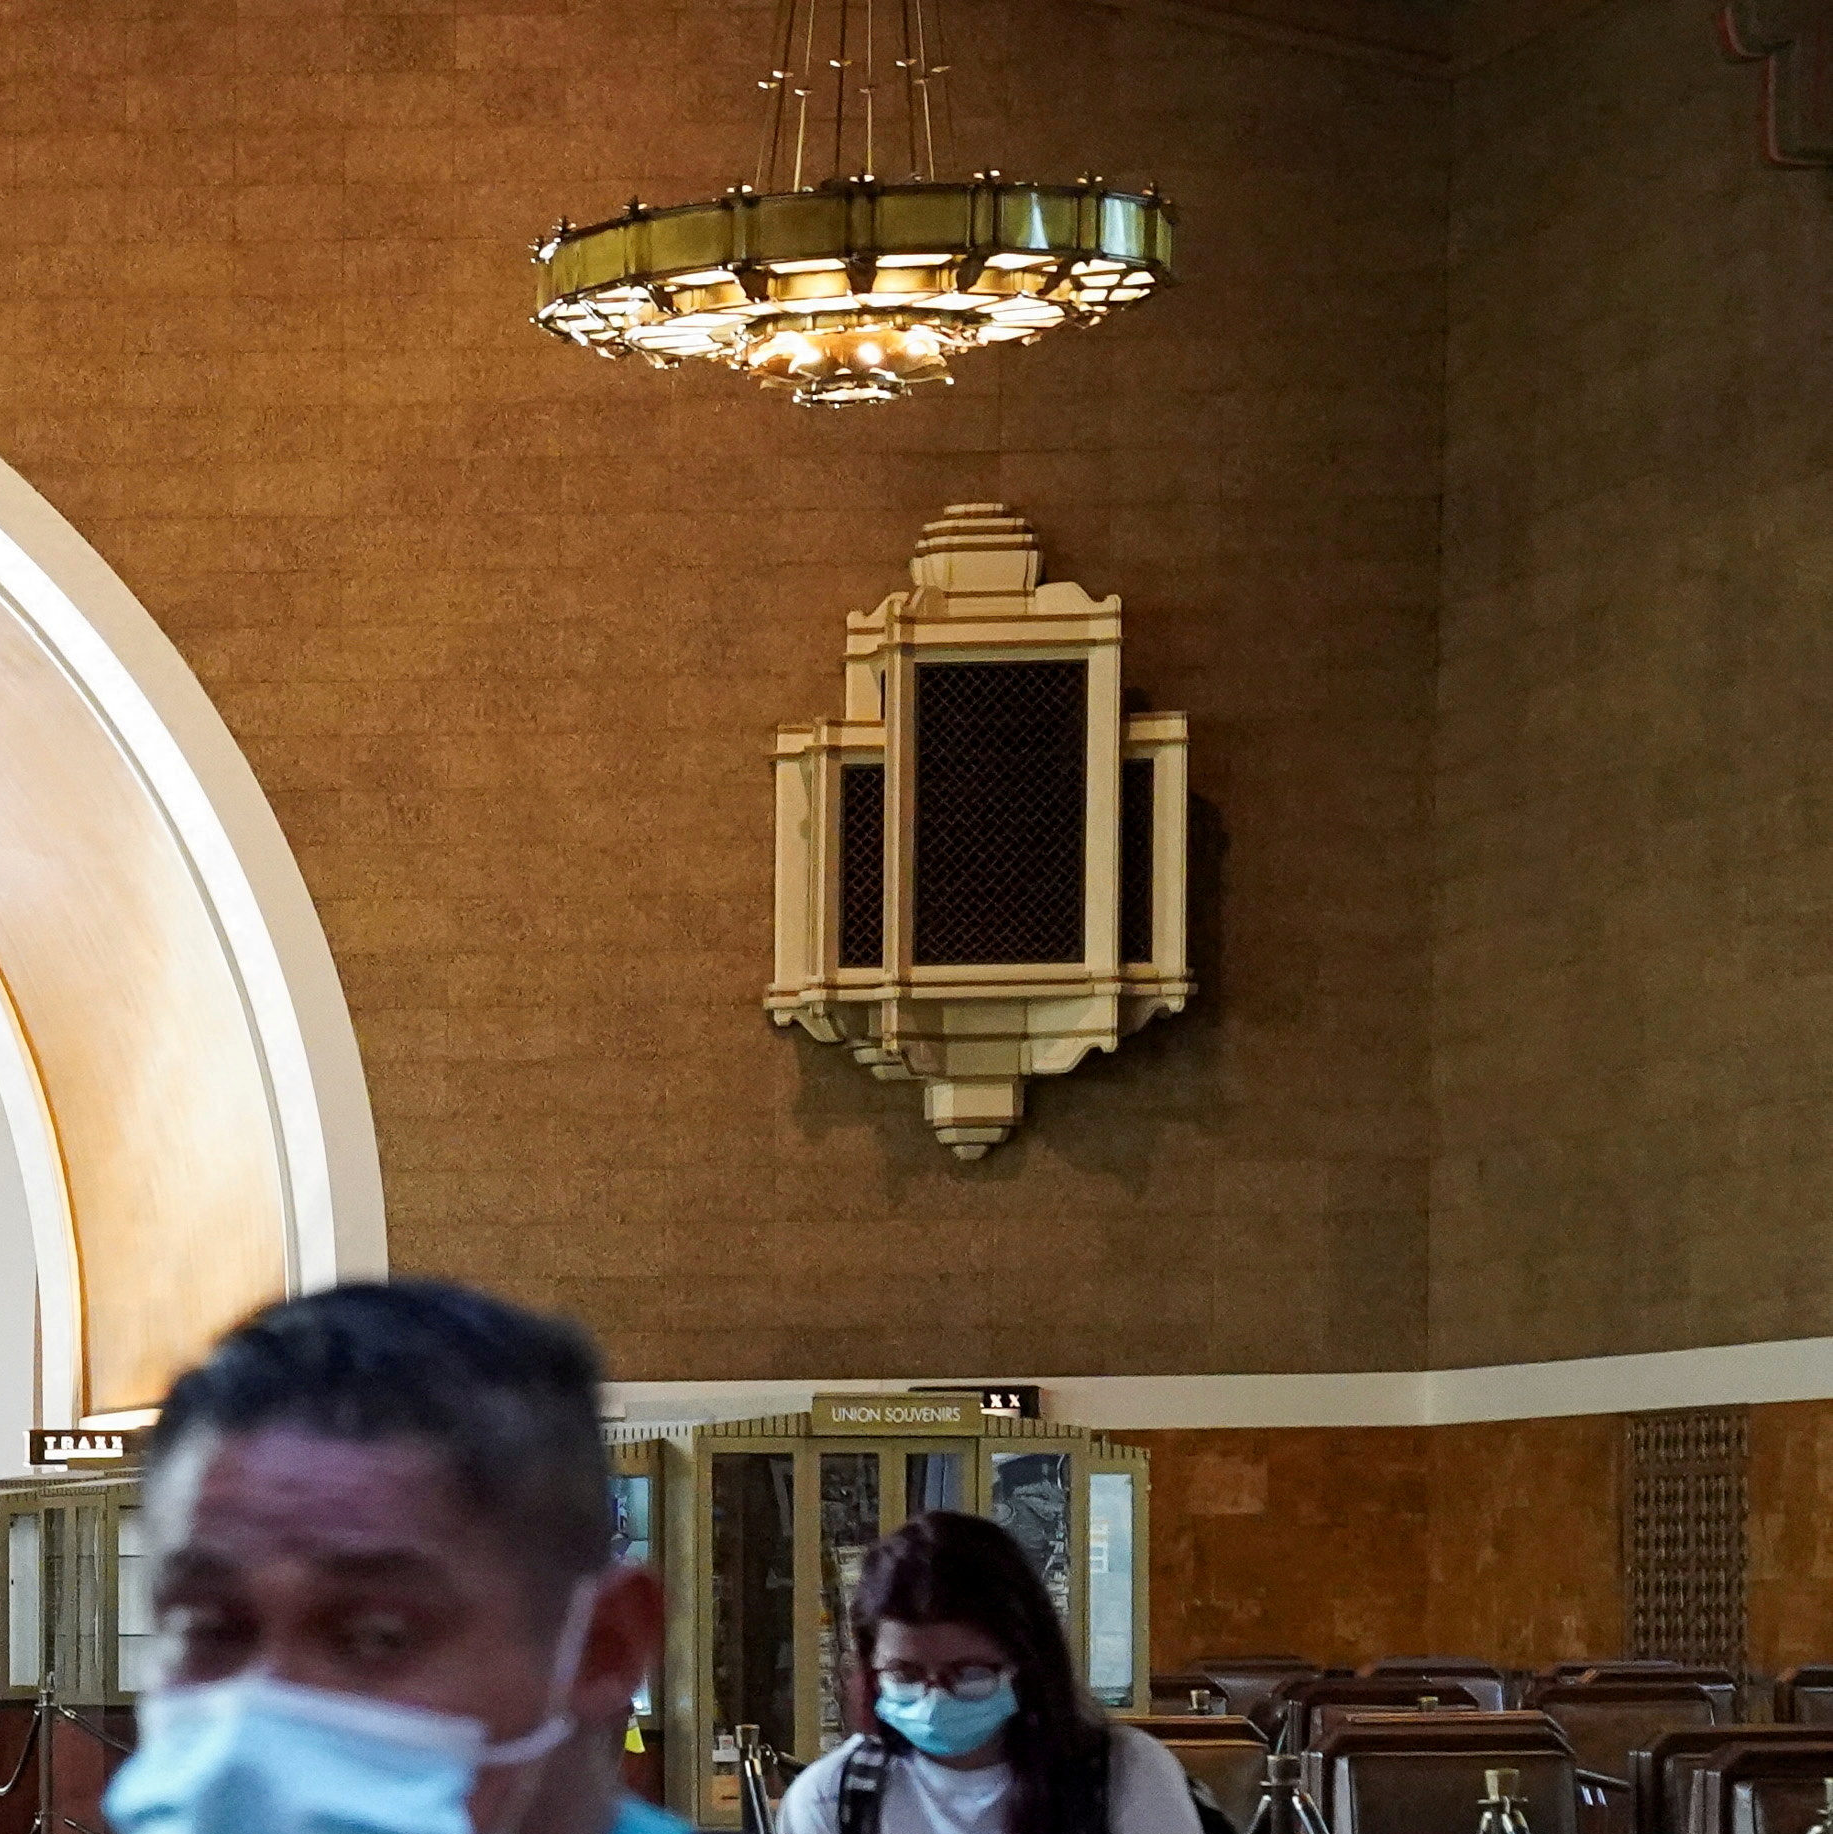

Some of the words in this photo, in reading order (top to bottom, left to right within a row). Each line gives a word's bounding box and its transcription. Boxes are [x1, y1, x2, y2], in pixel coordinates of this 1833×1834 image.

[832, 1407, 880, 1423] UNION
[885, 1406, 961, 1423] SOUVENIRS
[44, 1436, 123, 1450] TRAXX
